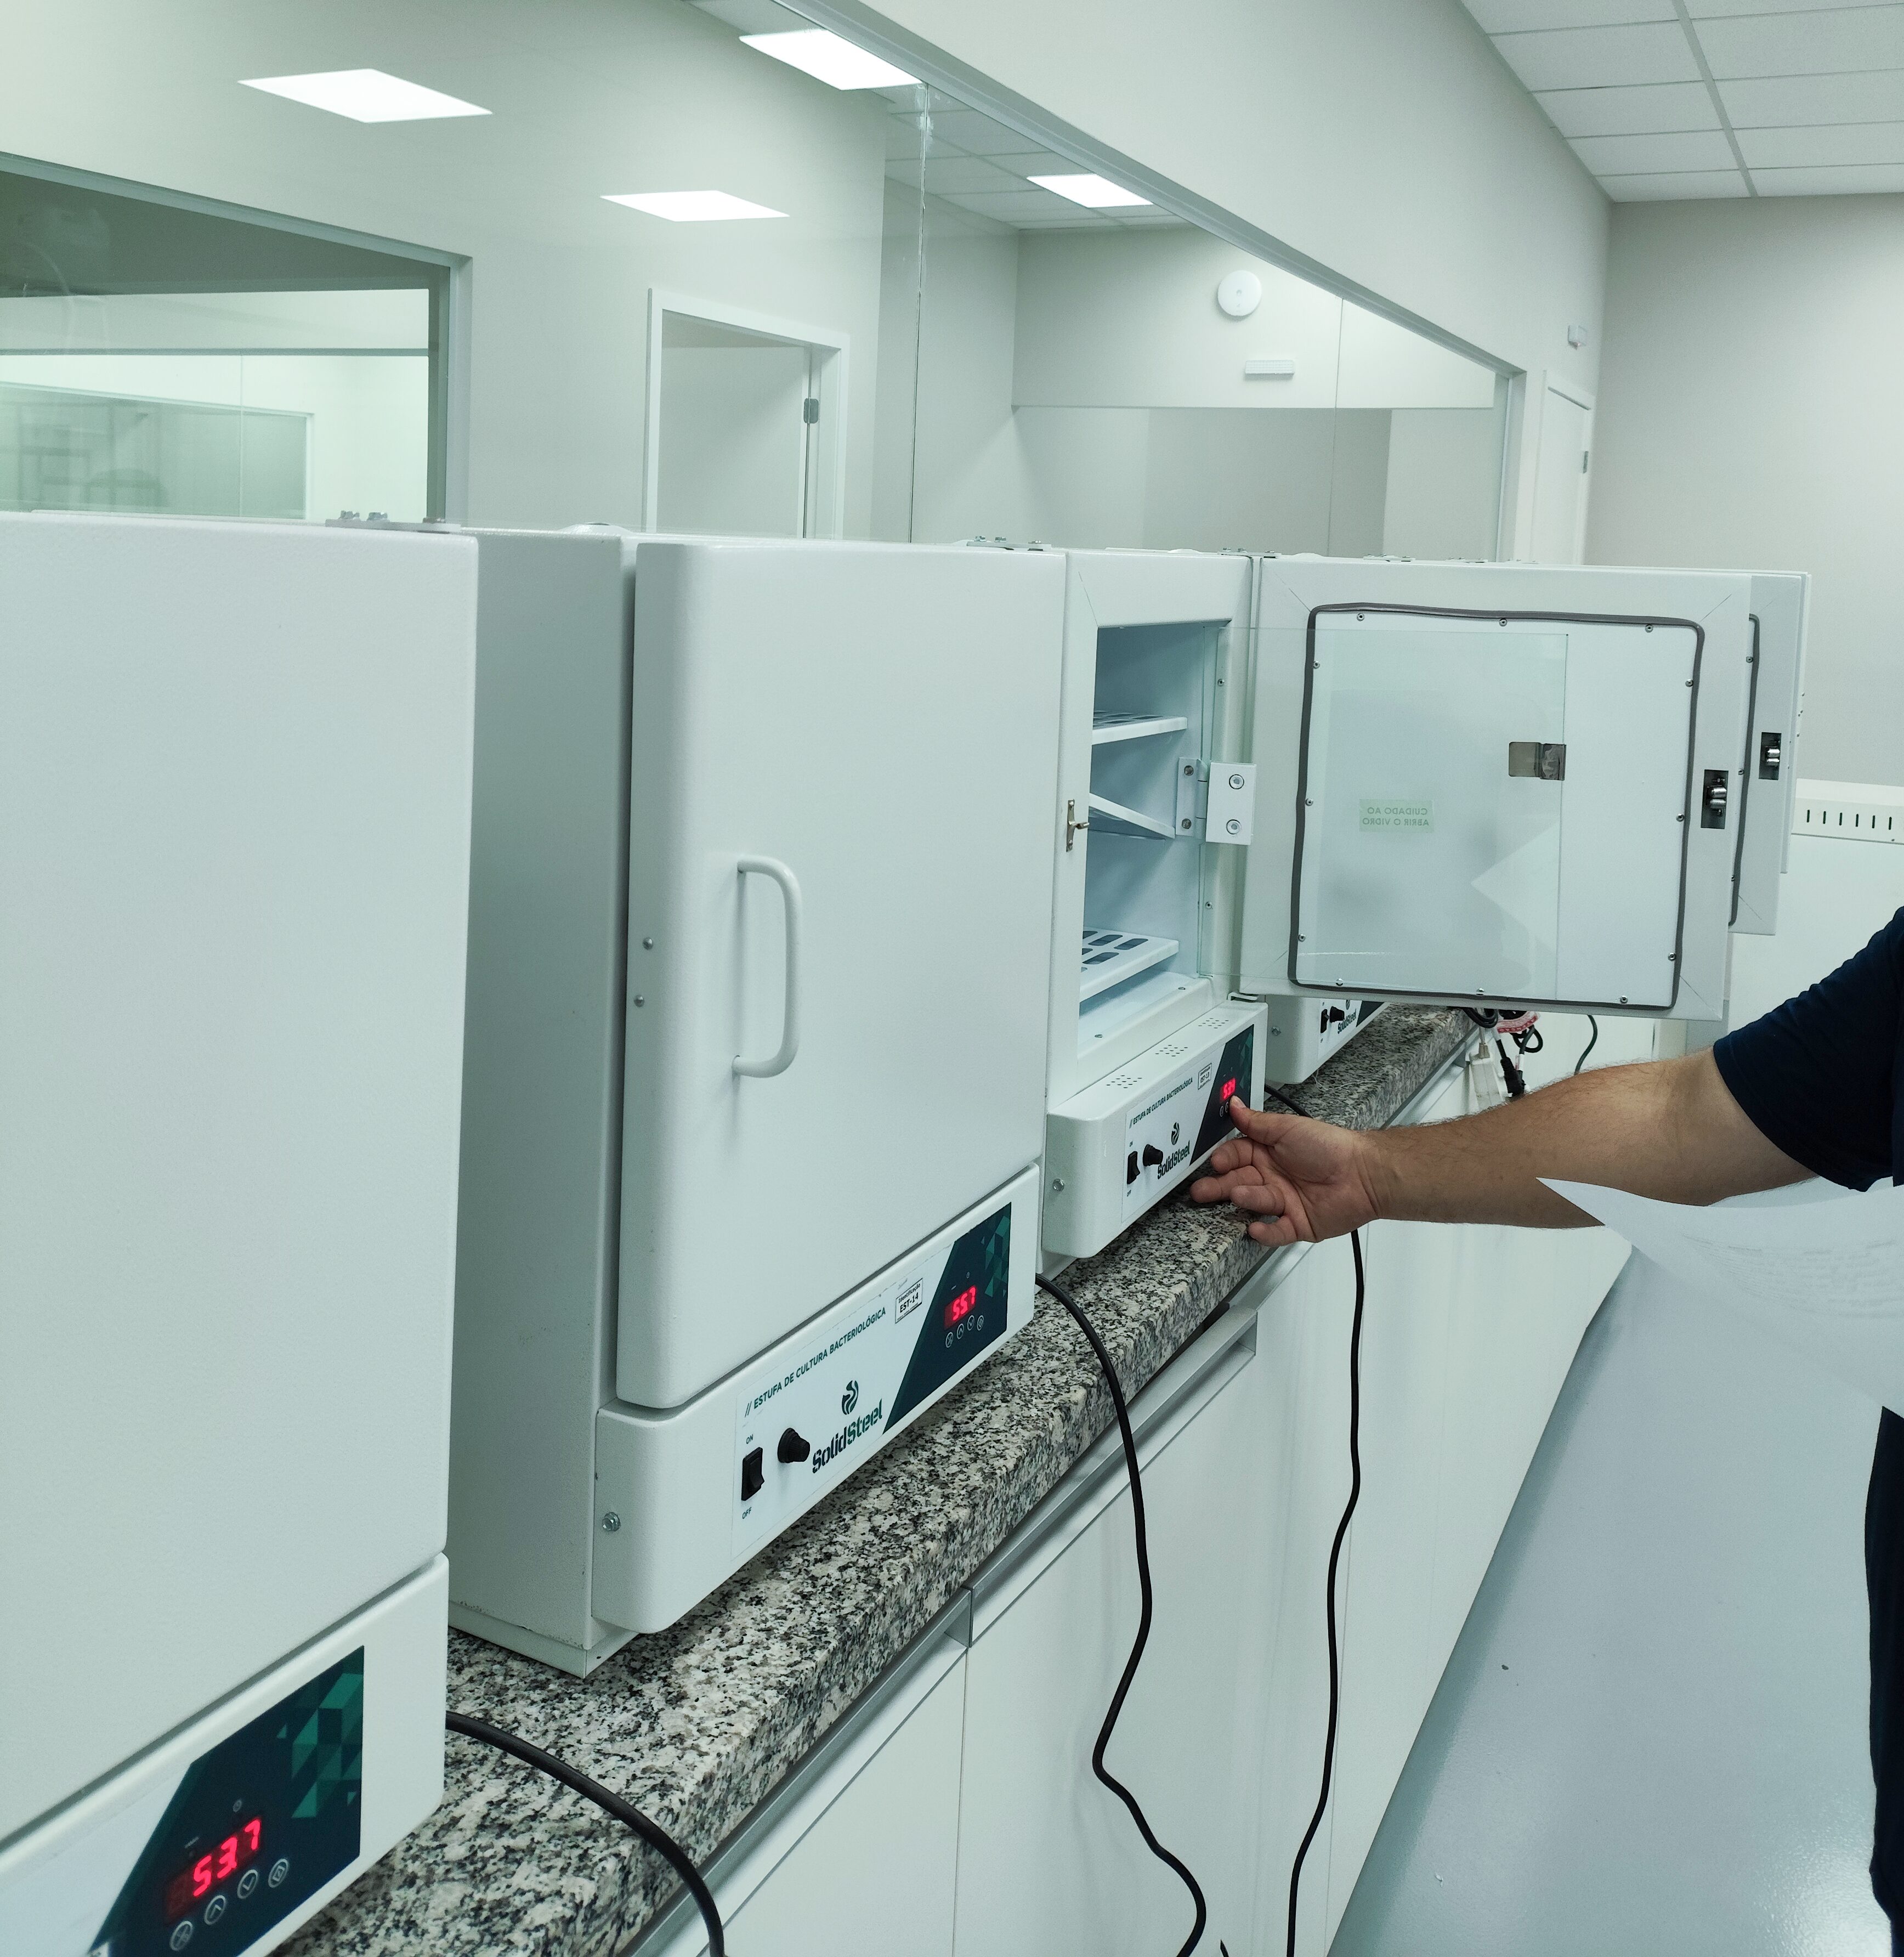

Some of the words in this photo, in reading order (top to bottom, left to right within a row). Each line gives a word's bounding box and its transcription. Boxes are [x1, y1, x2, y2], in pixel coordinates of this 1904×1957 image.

[1133, 1111, 1146, 1124] ESTUFA
[1146, 1106, 1151, 1116] DE
[1152, 1096, 1166, 1112] CULTURA
[1166, 1077, 1193, 1101] BACTERIOLÓGICA
[1157, 1140, 1190, 1180] SolidSteel
[898, 1283, 921, 1304] Identificação
[900, 1292, 919, 1313] EST-14
[753, 1382, 783, 1410] ESTUFA
[784, 1372, 795, 1387] DE
[796, 1349, 828, 1378] CULTURA
[830, 1306, 886, 1355] BACTERIOLÓGICA
[746, 1434, 753, 1444] ON
[812, 1398, 883, 1474] SolidSteel
[742, 1506, 752, 1519] OFF
